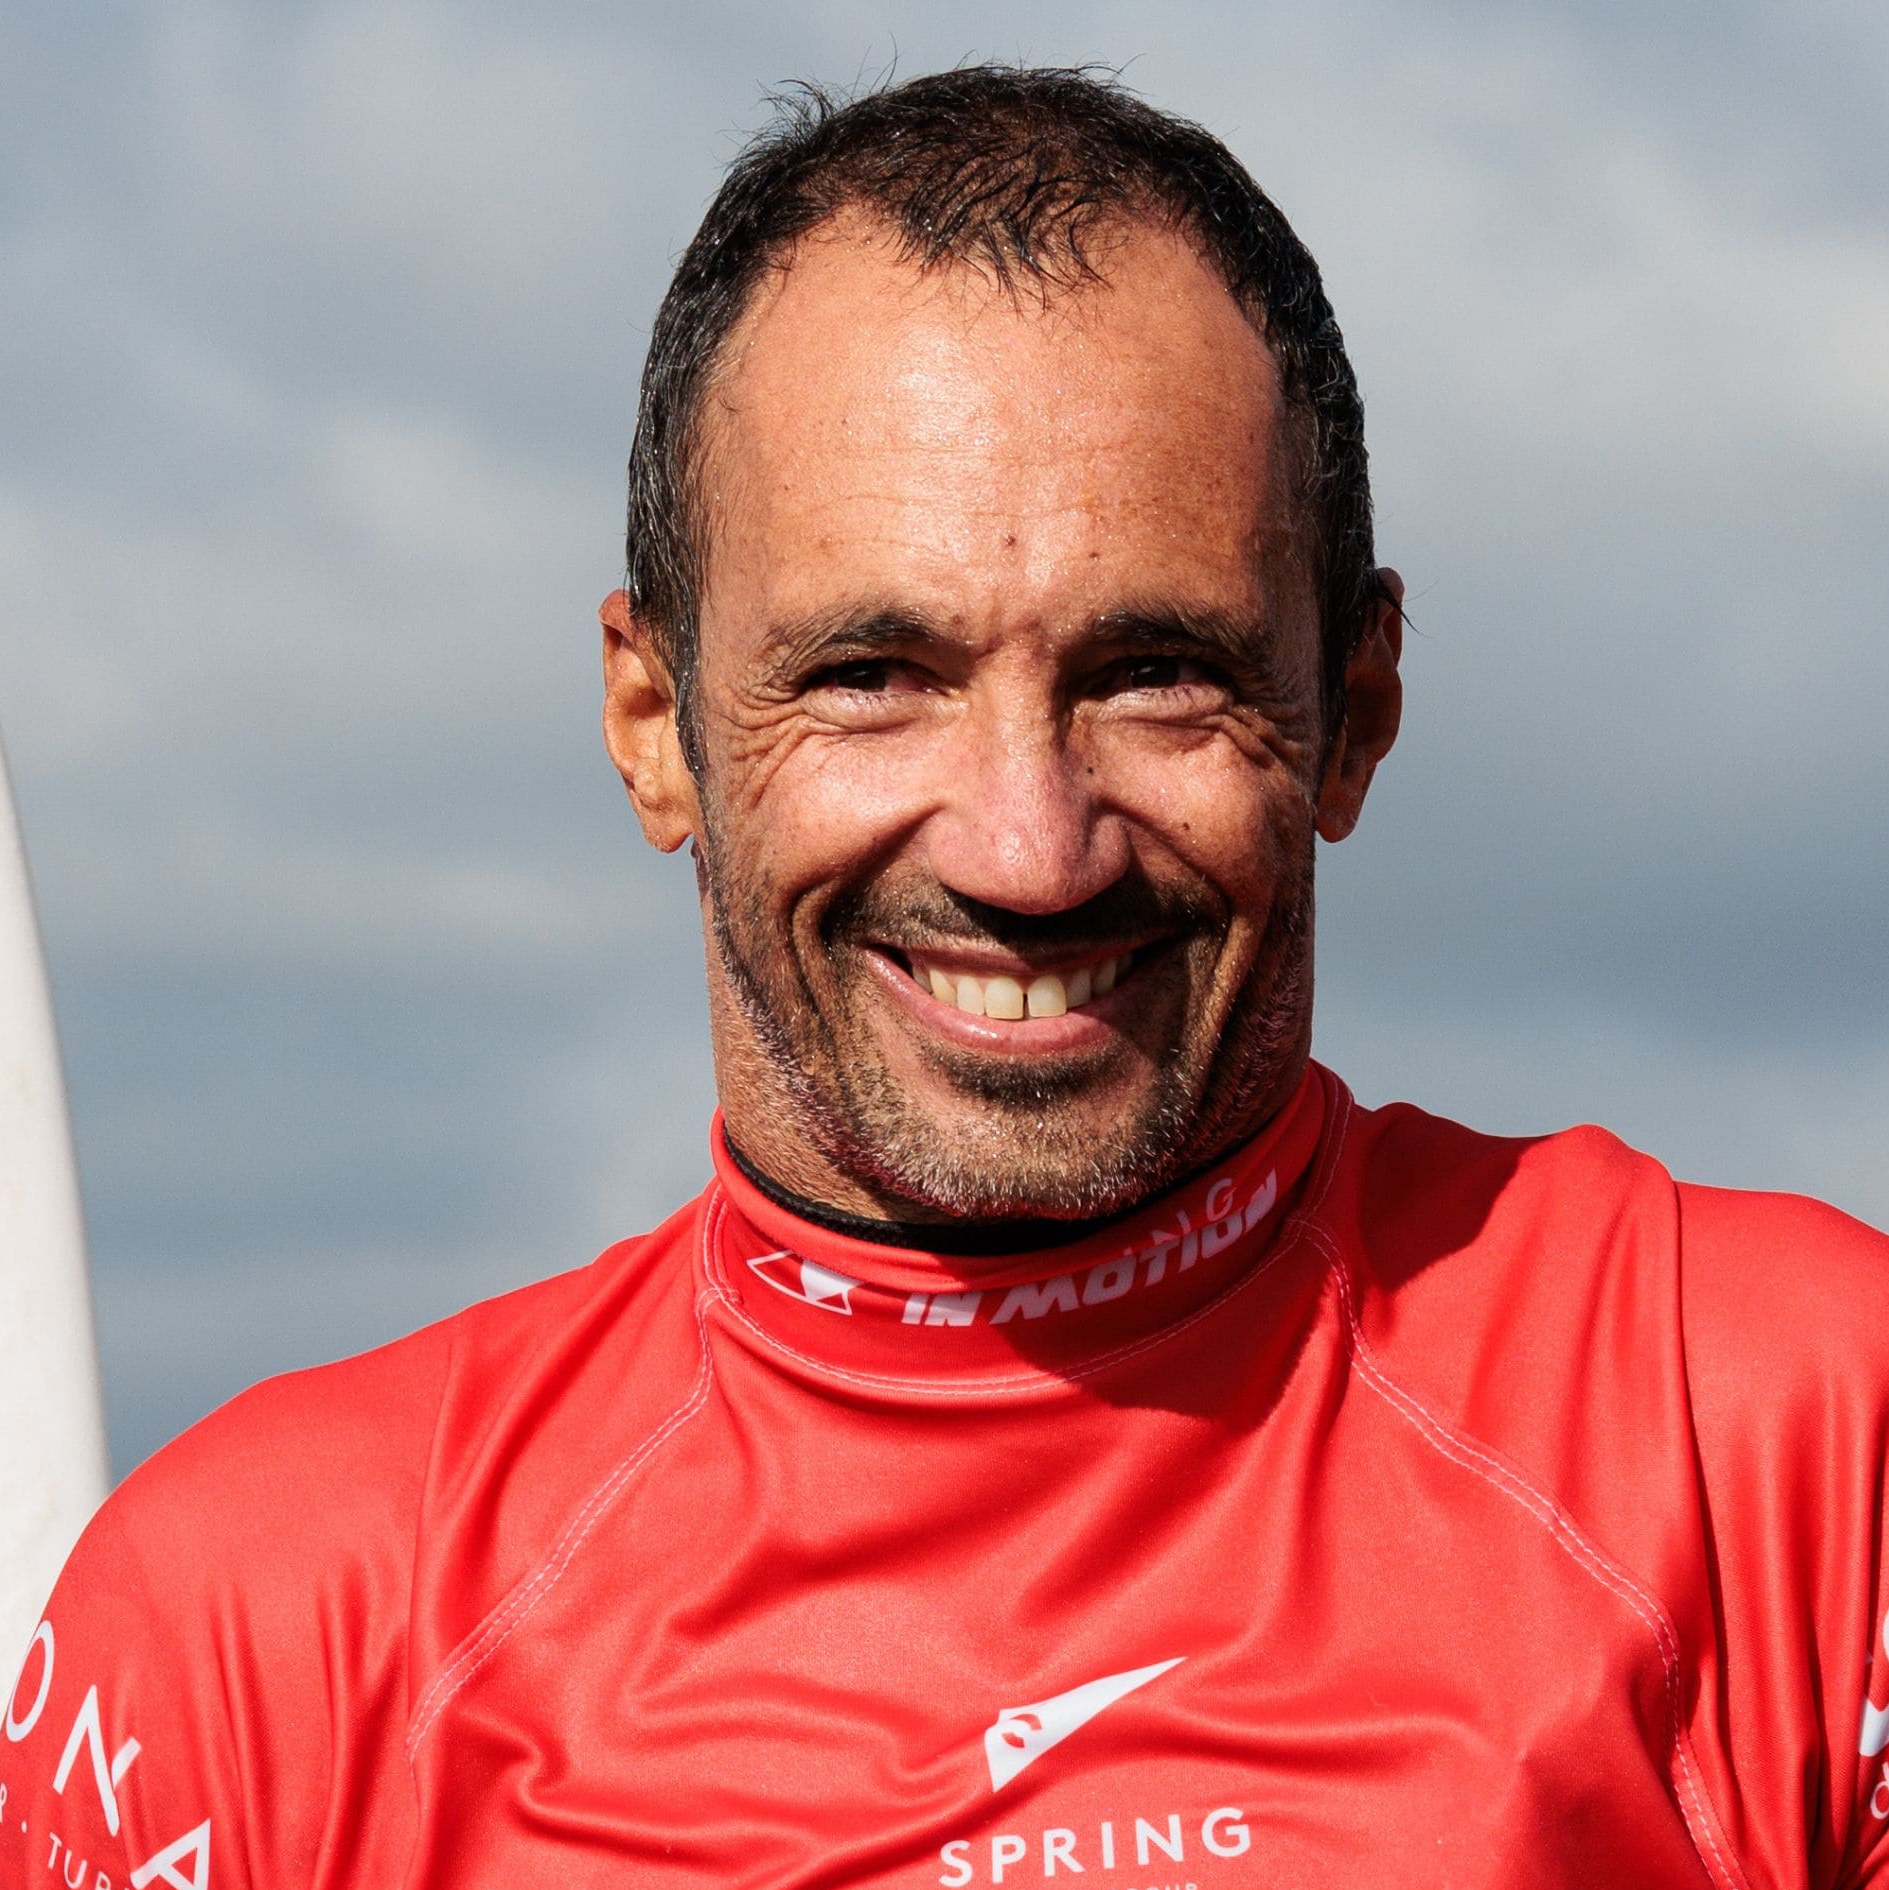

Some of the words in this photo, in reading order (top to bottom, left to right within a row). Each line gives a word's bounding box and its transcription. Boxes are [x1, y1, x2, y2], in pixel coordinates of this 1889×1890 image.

[901, 1291, 985, 1327] IN
[989, 1167, 1278, 1325] MOTION
[939, 1807, 1252, 1888] SPRING
